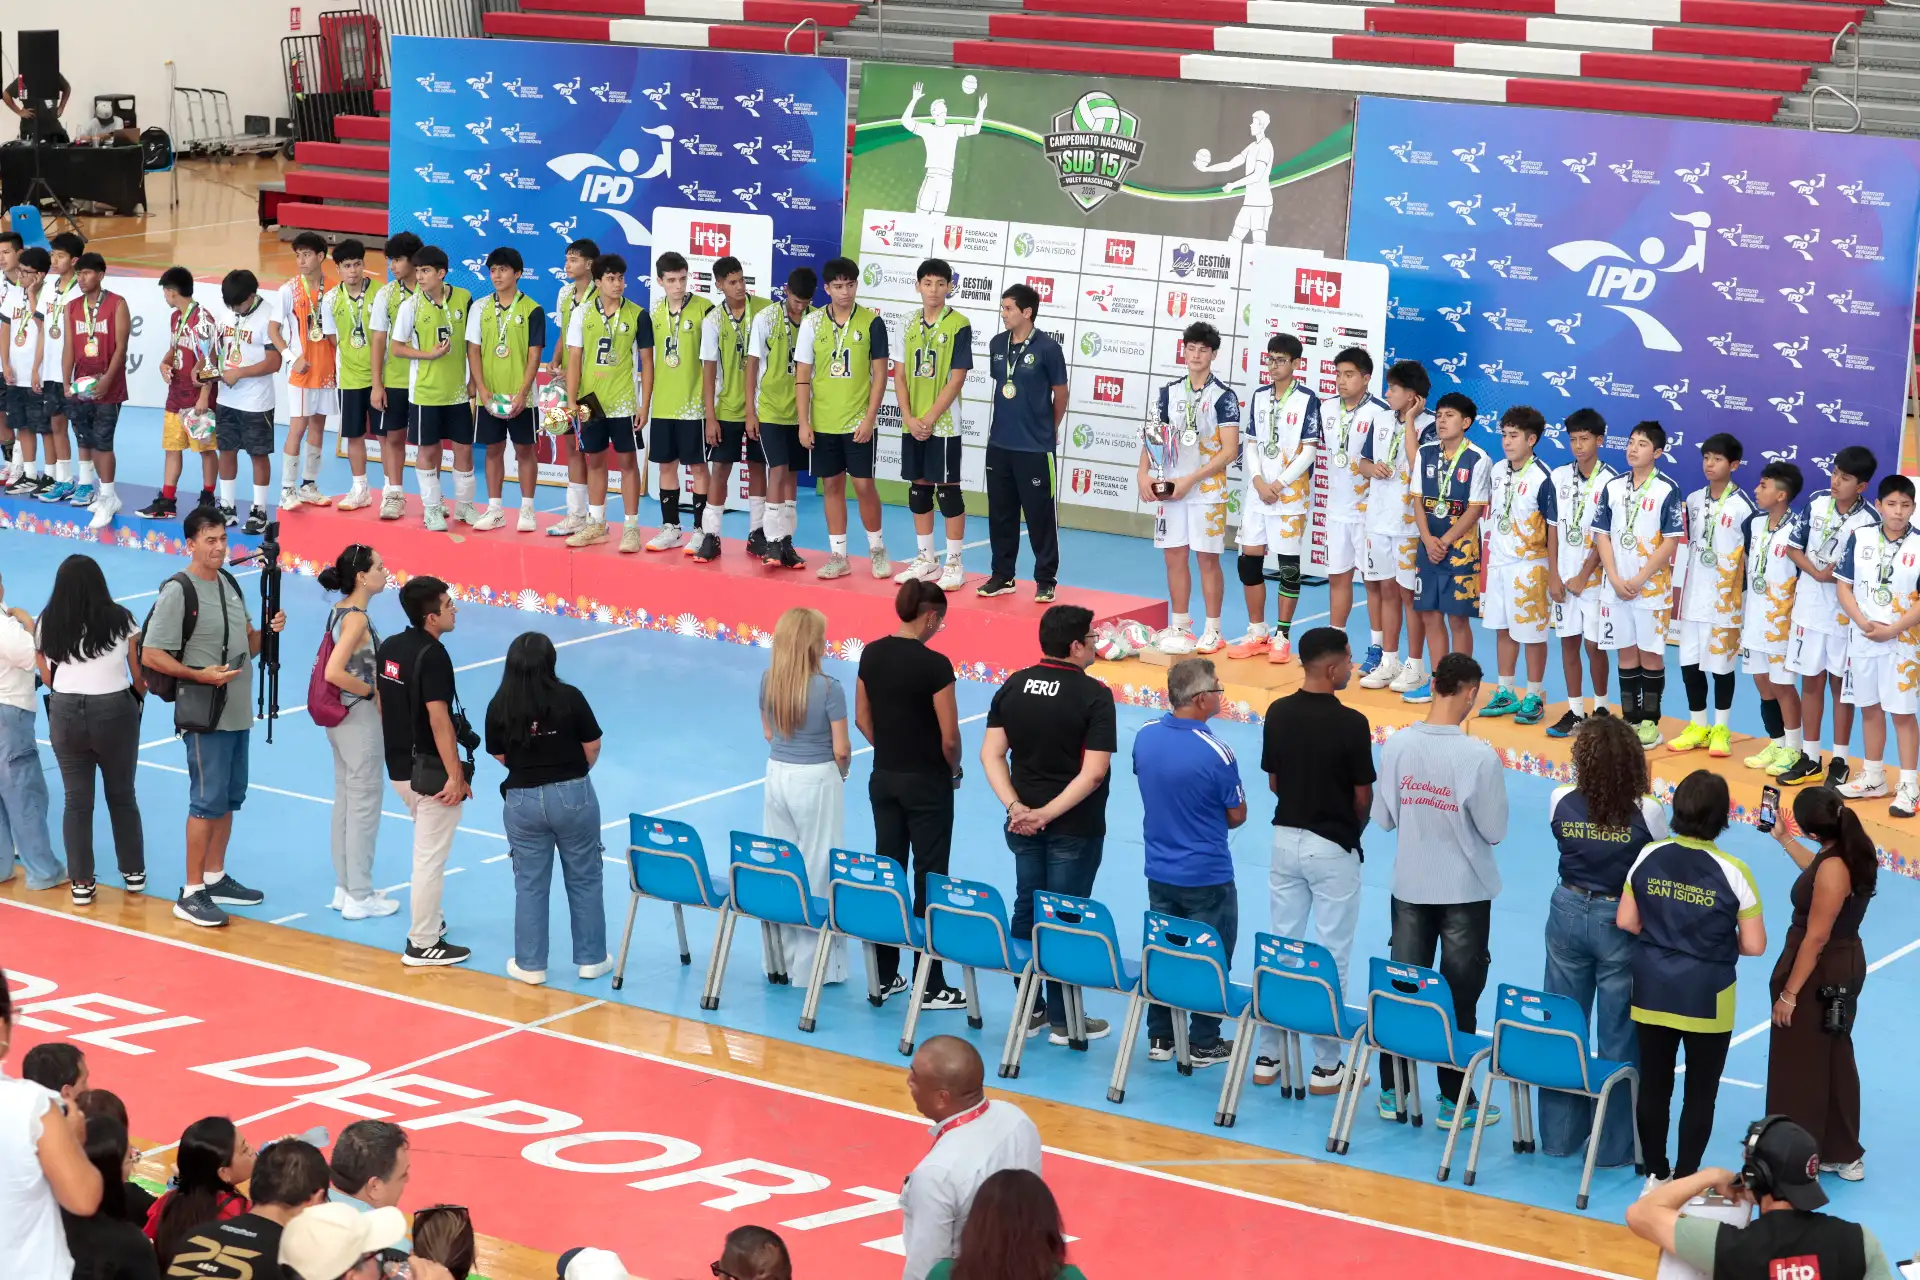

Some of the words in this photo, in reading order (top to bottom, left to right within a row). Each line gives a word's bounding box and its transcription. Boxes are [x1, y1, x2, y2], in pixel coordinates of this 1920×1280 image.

[472, 82, 484, 90] IPD
[560, 87, 572, 95] IPD
[650, 93, 662, 101] IPD
[742, 100, 754, 108] IPD
[1050, 134, 1099, 148] CAMPEONATO
[1100, 136, 1137, 154] NACIONAL
[1460, 154, 1474, 162] IPD
[1062, 150, 1095, 174] SUB
[1100, 151, 1120, 177] 15
[1570, 164, 1585, 172] IPD
[1083, 177, 1113, 187] MASCULINO
[1683, 174, 1698, 182] IPD
[580, 174, 634, 204] IPD
[1798, 186, 1813, 194] IPD
[740, 193, 752, 201] IPD
[1456, 206, 1470, 214] IPD
[557, 226, 568, 234] IPD
[965, 229, 998, 238] FEDERACIÓN
[695, 226, 727, 253] irtp
[964, 244, 989, 252] VOLEIBOL
[1792, 241, 1808, 249] IPD
[1035, 246, 1051, 254] SAN
[1051, 248, 1076, 256] ISIDRO
[1109, 242, 1132, 262] irtp
[1198, 254, 1231, 269] GESTIÓN
[1451, 260, 1466, 268] IPD
[1196, 268, 1229, 280] DEPORTIVA
[883, 275, 898, 283] SAN
[898, 277, 916, 285] ISIDR
[963, 276, 993, 291] GESTIÓN
[1587, 265, 1656, 301] IPD
[1030, 279, 1051, 299] irtp
[1300, 273, 1337, 303] irtp
[961, 290, 991, 302] DEPORTIVA
[1190, 297, 1226, 305] FEDERACIÓN
[1788, 294, 1803, 302] IPD
[1190, 305, 1216, 313] PERUANA
[1189, 312, 1216, 320] VOLEIBOL
[1446, 313, 1460, 321] IPD
[1555, 324, 1570, 333] IPD
[596, 337, 612, 365] 2
[1103, 345, 1118, 353] SAN
[1119, 347, 1144, 356] ISIDRO
[1782, 348, 1797, 356] IPD
[1322, 362, 1336, 372] irtp
[1441, 364, 1456, 372] IPD
[1321, 381, 1336, 391] irtp
[1550, 377, 1565, 386] IPD
[1097, 379, 1121, 400] irtp
[1662, 391, 1677, 399] IPD
[1777, 404, 1792, 412] IPD
[1544, 429, 1559, 438] IPD
[1111, 440, 1137, 449] ISIDRO
[1094, 473, 1129, 483] FEDERACIÓN
[1093, 481, 1119, 489] PERUANA
[1093, 488, 1119, 497] VOLEIBOL
[1604, 622, 1614, 639] 2
[1796, 639, 1803, 659] 7
[386, 662, 399, 677] irtp
[1023, 678, 1061, 697] PERÚ
[1400, 774, 1451, 797] Accelerate
[1415, 796, 1459, 812] ambitions
[1561, 821, 1574, 829] LIGA
[1562, 827, 1584, 839] SAN
[1587, 829, 1631, 843] ISIDRO
[1647, 878, 1661, 886] LIGA
[1673, 881, 1704, 895] VOLEIBOL
[1706, 889, 1716, 897] DE
[1647, 885, 1670, 898] SAN
[1673, 890, 1715, 907] ISIDRO
[187, 1046, 908, 1257] DEPORT
[167, 1235, 262, 1280] 25
